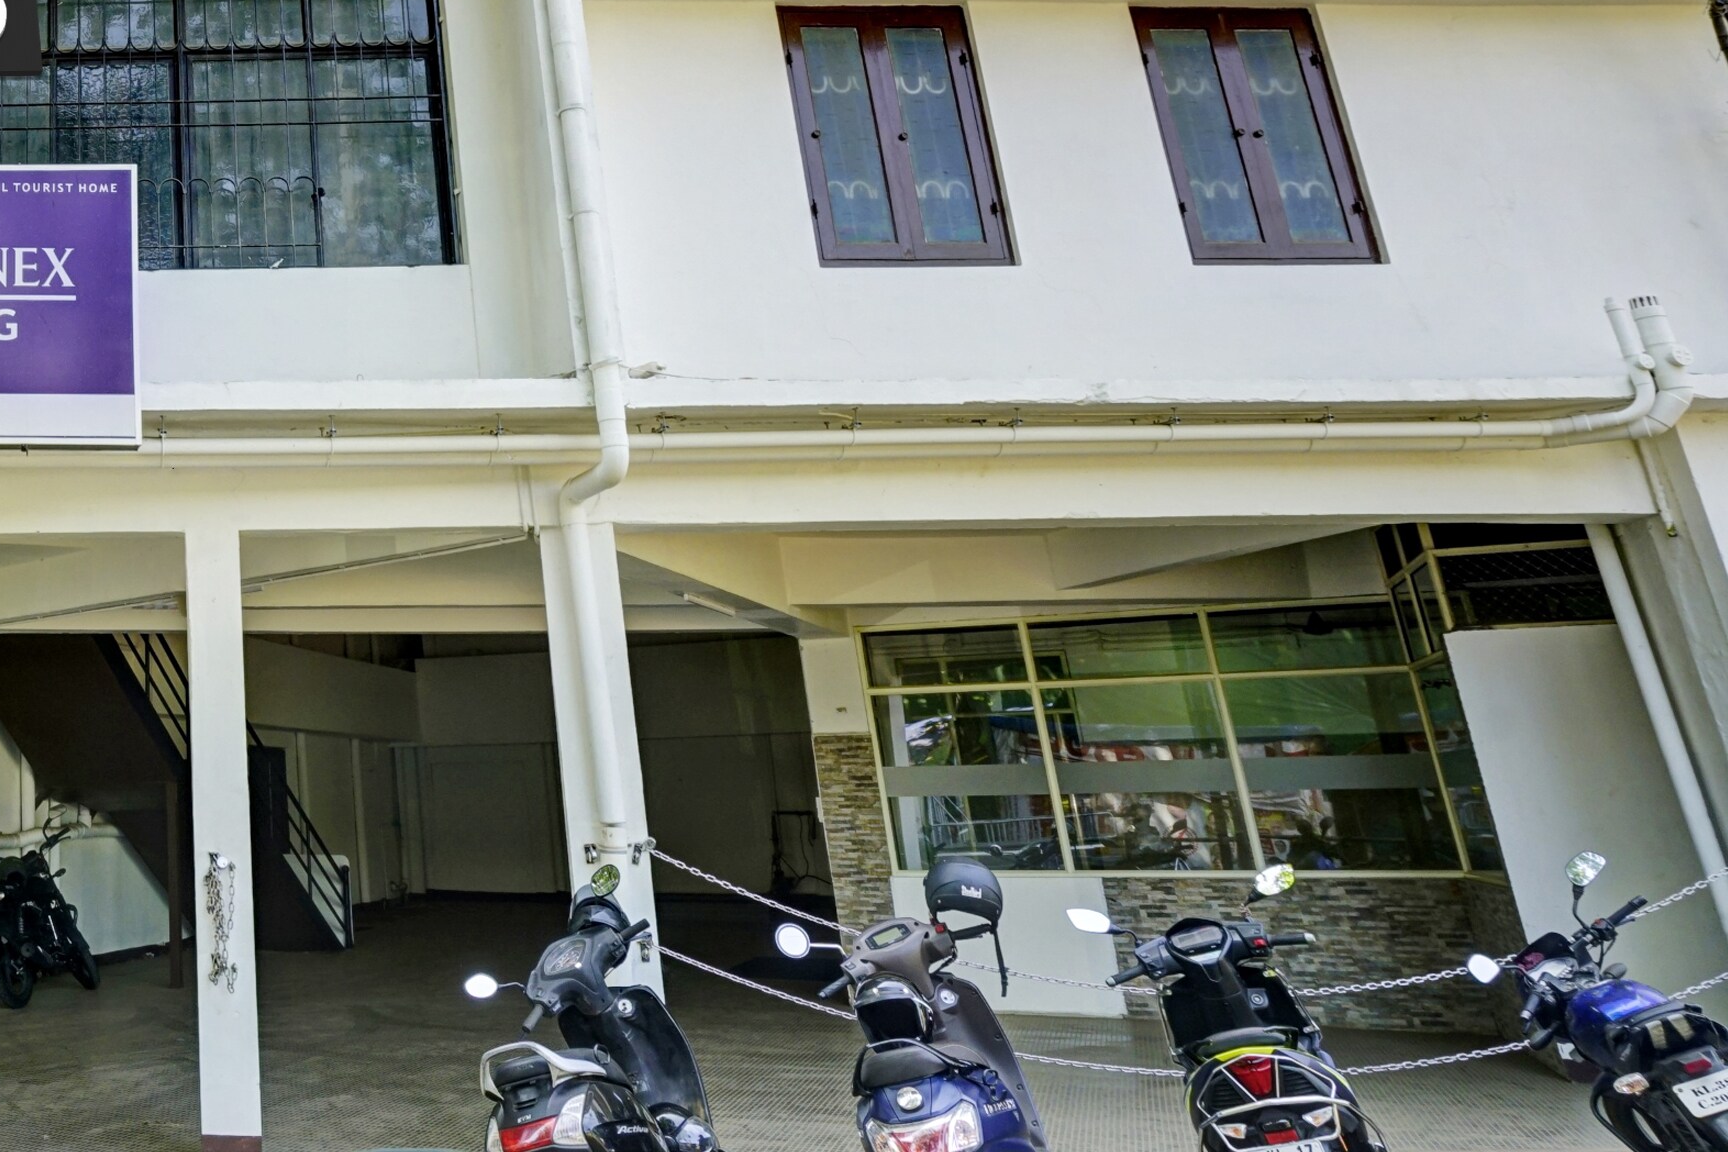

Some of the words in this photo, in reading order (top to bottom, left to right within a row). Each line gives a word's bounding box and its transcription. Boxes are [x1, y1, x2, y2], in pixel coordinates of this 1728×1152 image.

[13, 182, 74, 194] TOURIST
[78, 183, 118, 194] HOME
[616, 1124, 649, 1135] Activa
